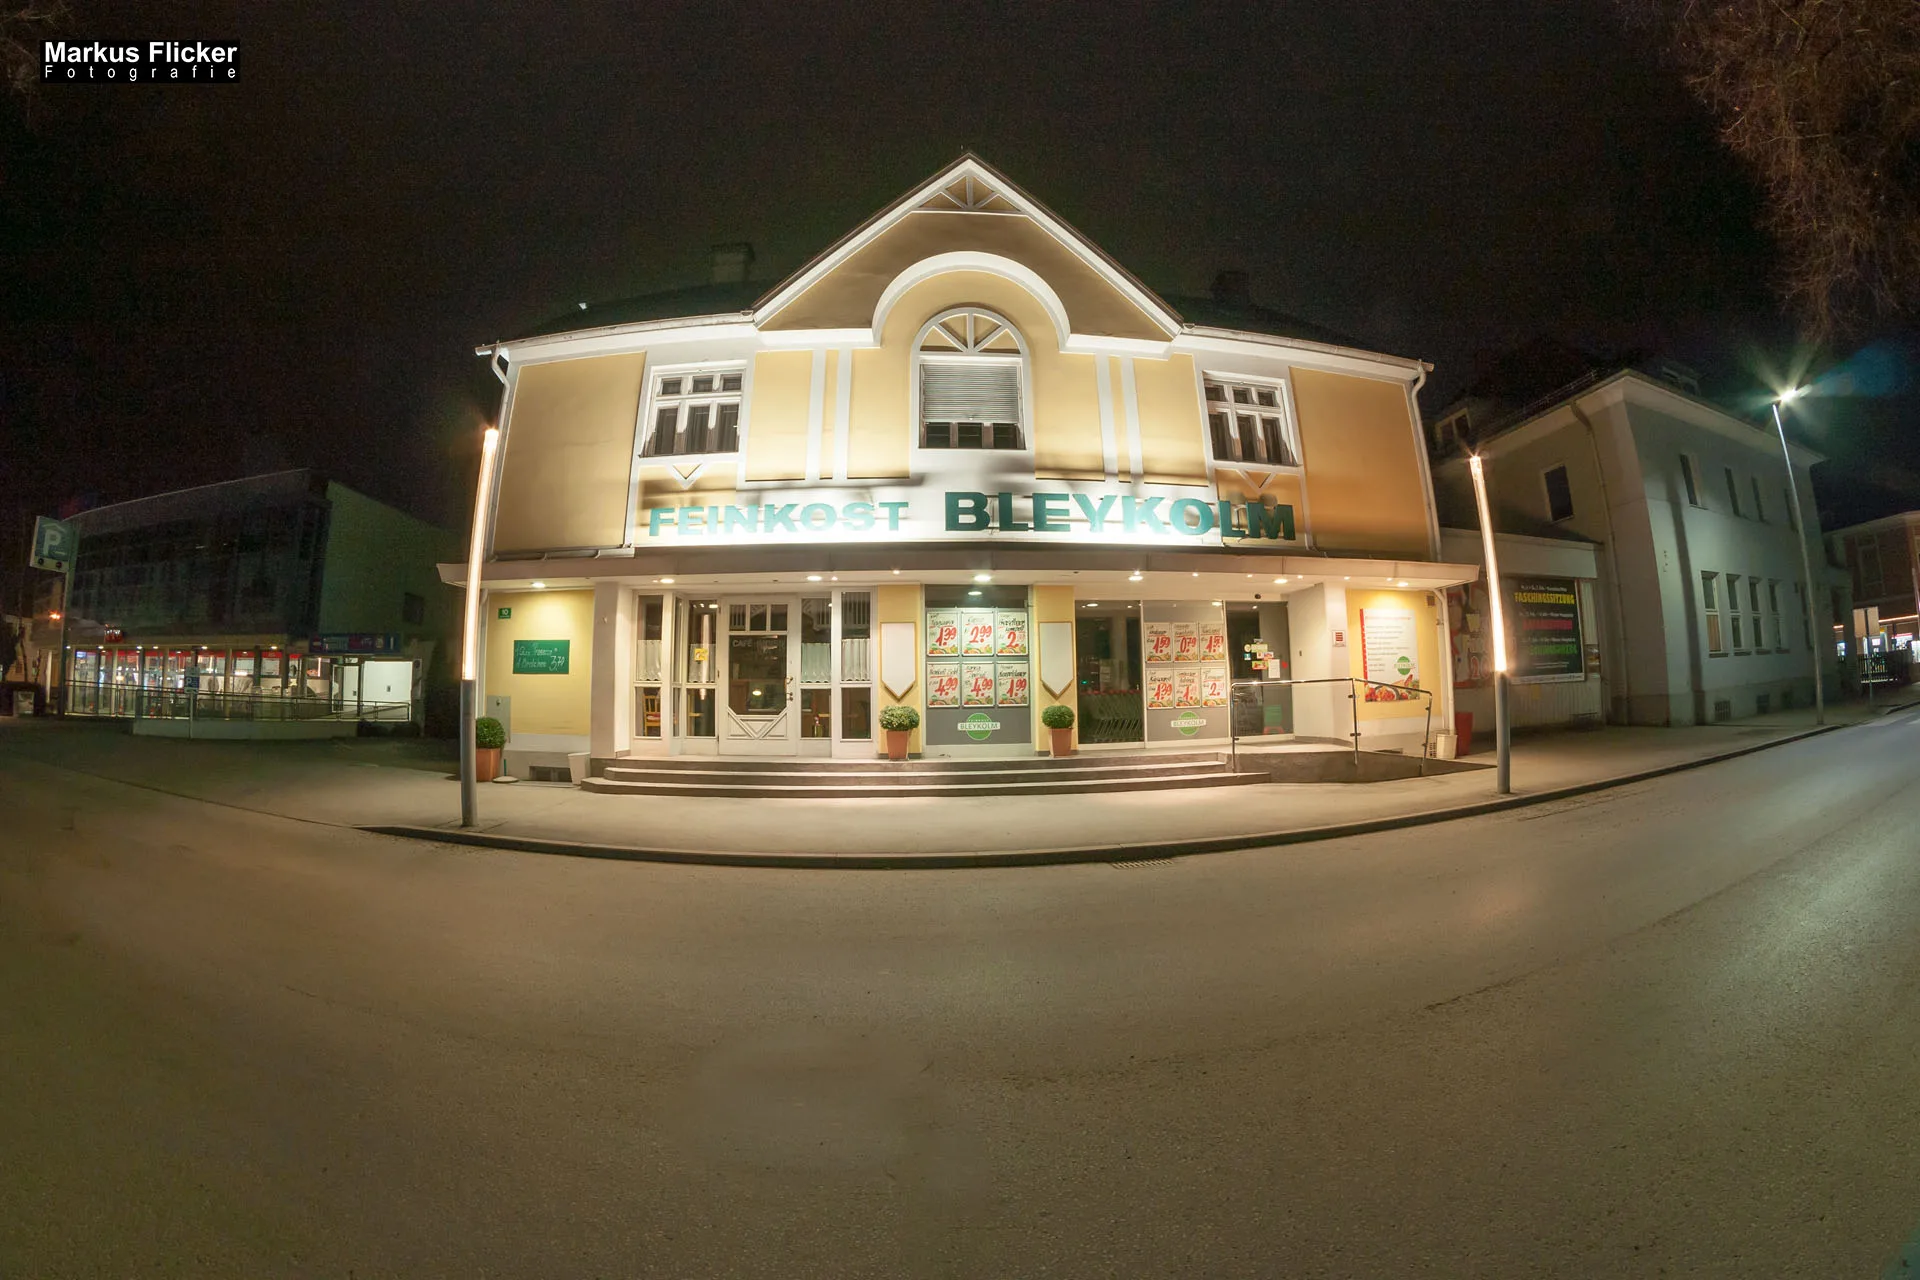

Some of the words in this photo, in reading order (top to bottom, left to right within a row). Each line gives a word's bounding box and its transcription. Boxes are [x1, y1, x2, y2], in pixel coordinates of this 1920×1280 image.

[648, 501, 909, 537] FEINKOST
[944, 491, 1296, 541] BLEYKOLM
[960, 722, 998, 730] BLEYKOLM
